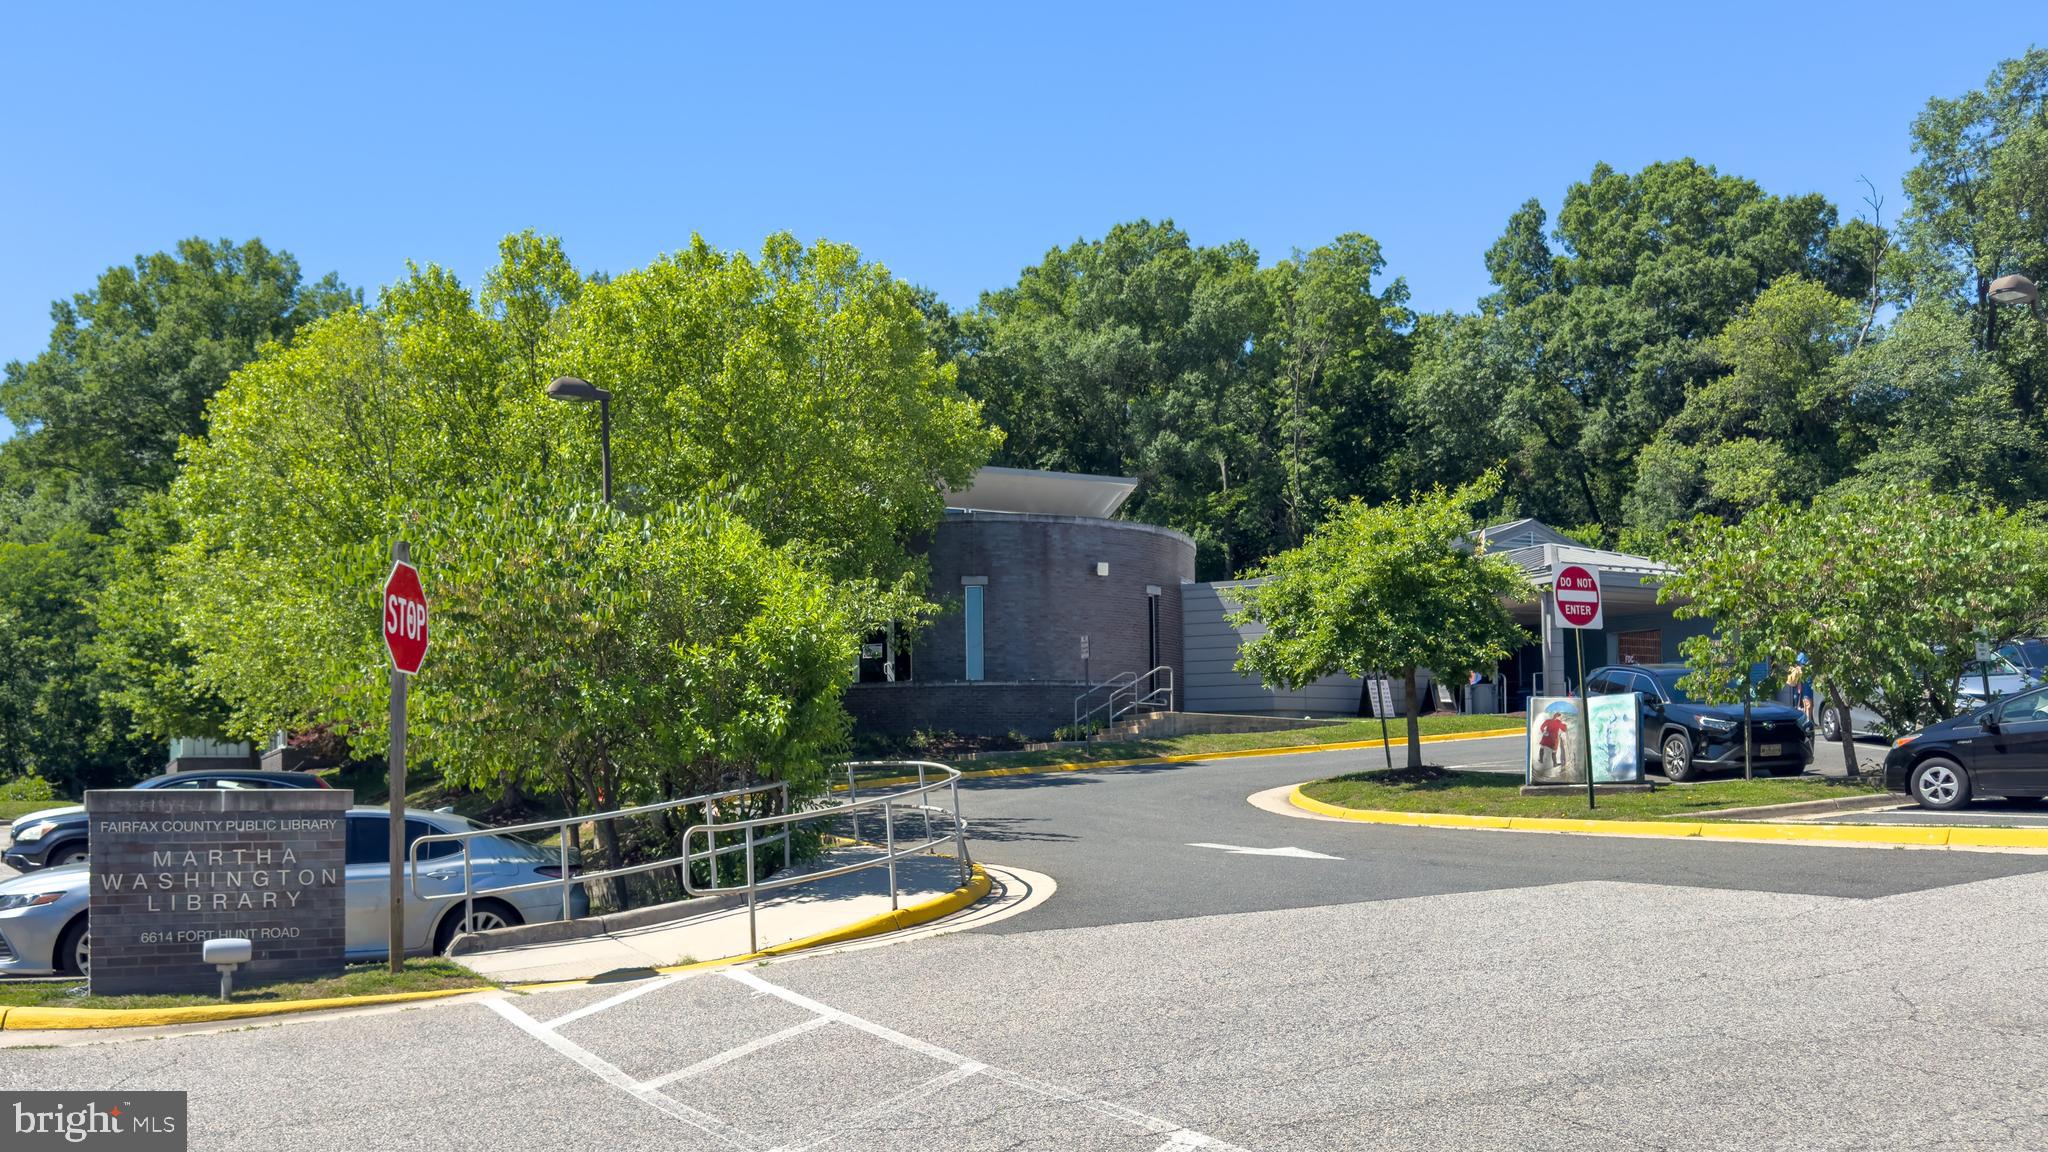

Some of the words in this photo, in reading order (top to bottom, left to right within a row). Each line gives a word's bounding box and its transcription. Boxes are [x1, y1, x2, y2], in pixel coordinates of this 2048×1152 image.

[1560, 577, 1571, 587] DO
[1577, 578, 1592, 588] NOT
[387, 594, 426, 641] STOP
[1565, 604, 1591, 615] ENTER
[100, 821, 159, 833] FAIRFAX
[162, 820, 222, 832] COUNTY
[226, 819, 277, 832] PUBLIC
[281, 819, 337, 830] LIBRARY
[153, 848, 296, 867] MARTHA
[101, 869, 336, 890] WASHINGTON
[148, 892, 301, 912] LIBRARY
[141, 931, 173, 943] 6614
[177, 930, 215, 942] FORT
[219, 928, 257, 940] HUNT
[261, 927, 300, 939] ROAD
